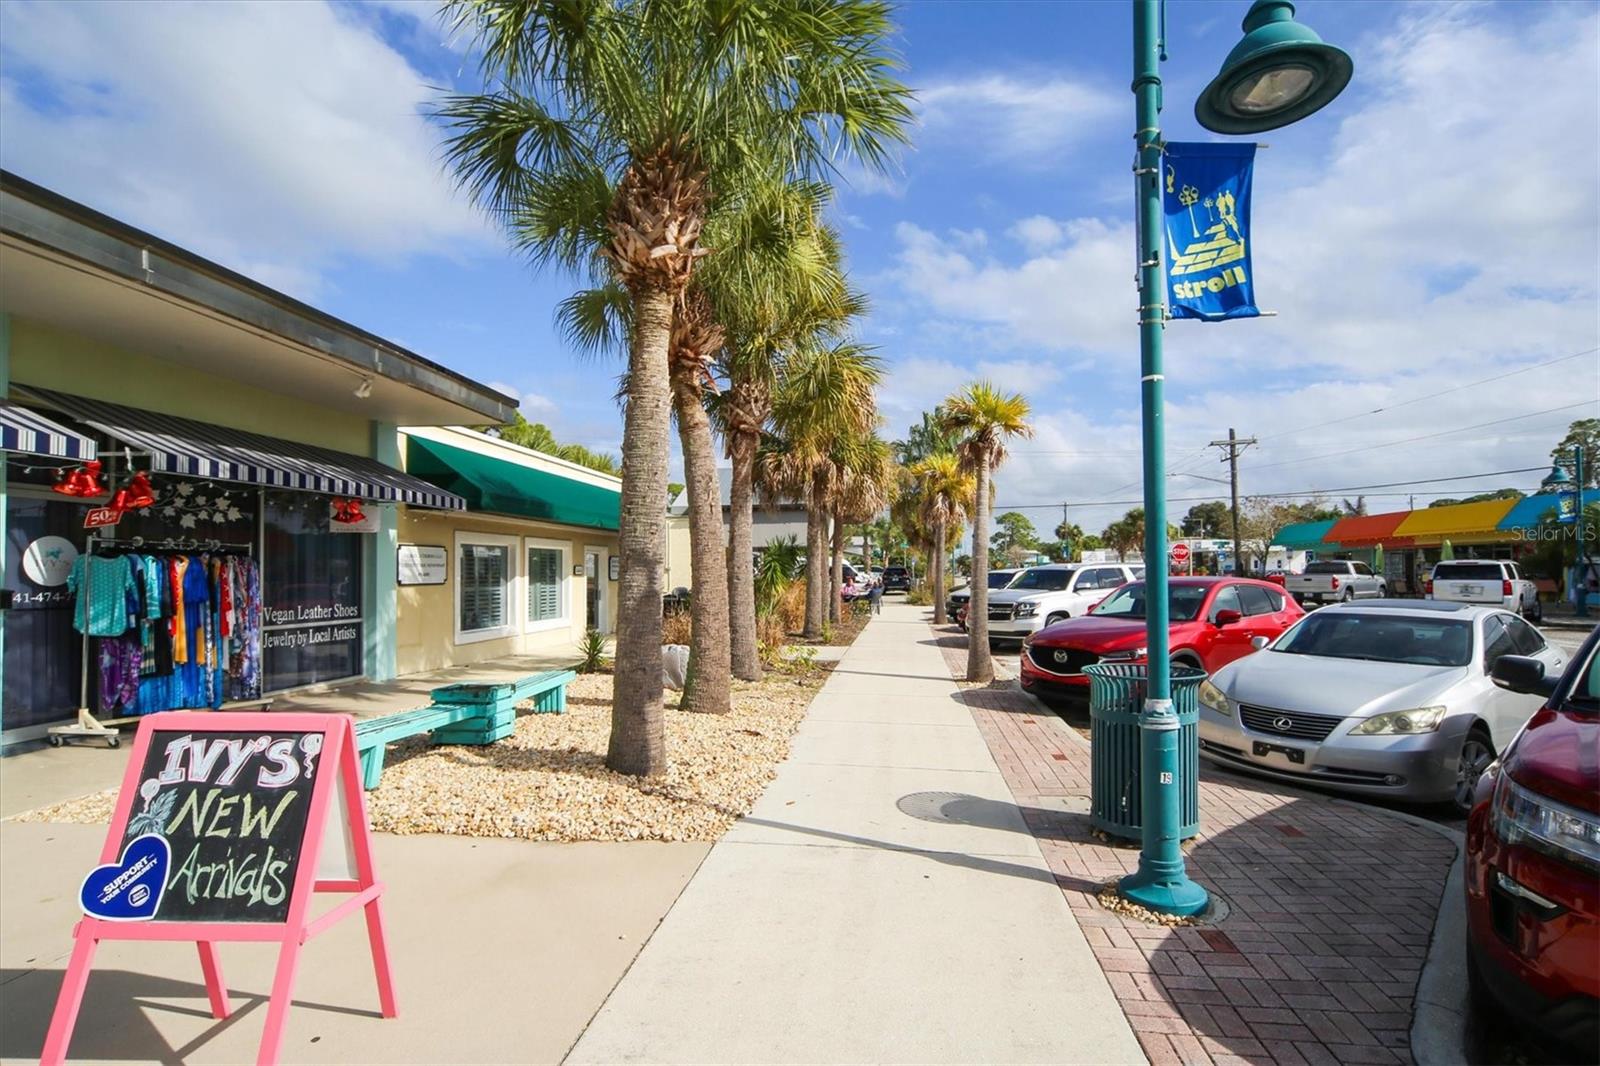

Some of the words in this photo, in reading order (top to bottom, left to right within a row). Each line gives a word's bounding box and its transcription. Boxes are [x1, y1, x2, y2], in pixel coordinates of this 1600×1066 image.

[1173, 265, 1247, 299] stroll
[1173, 548, 1188, 556] STOP
[263, 607, 295, 624] Vegan
[297, 604, 333, 620] Leather
[334, 603, 358, 617] Shoes
[263, 631, 297, 648] Jewelry
[297, 630, 308, 647] by
[309, 627, 331, 644] Local
[332, 625, 357, 641] Artists
[159, 734, 300, 788] IVY'S
[165, 788, 298, 840] NEW
[100, 889, 121, 904] YOUR
[119, 857, 158, 891] COMMUNITY
[103, 855, 149, 894] SUPPORT
[168, 843, 289, 907] Arrivals
